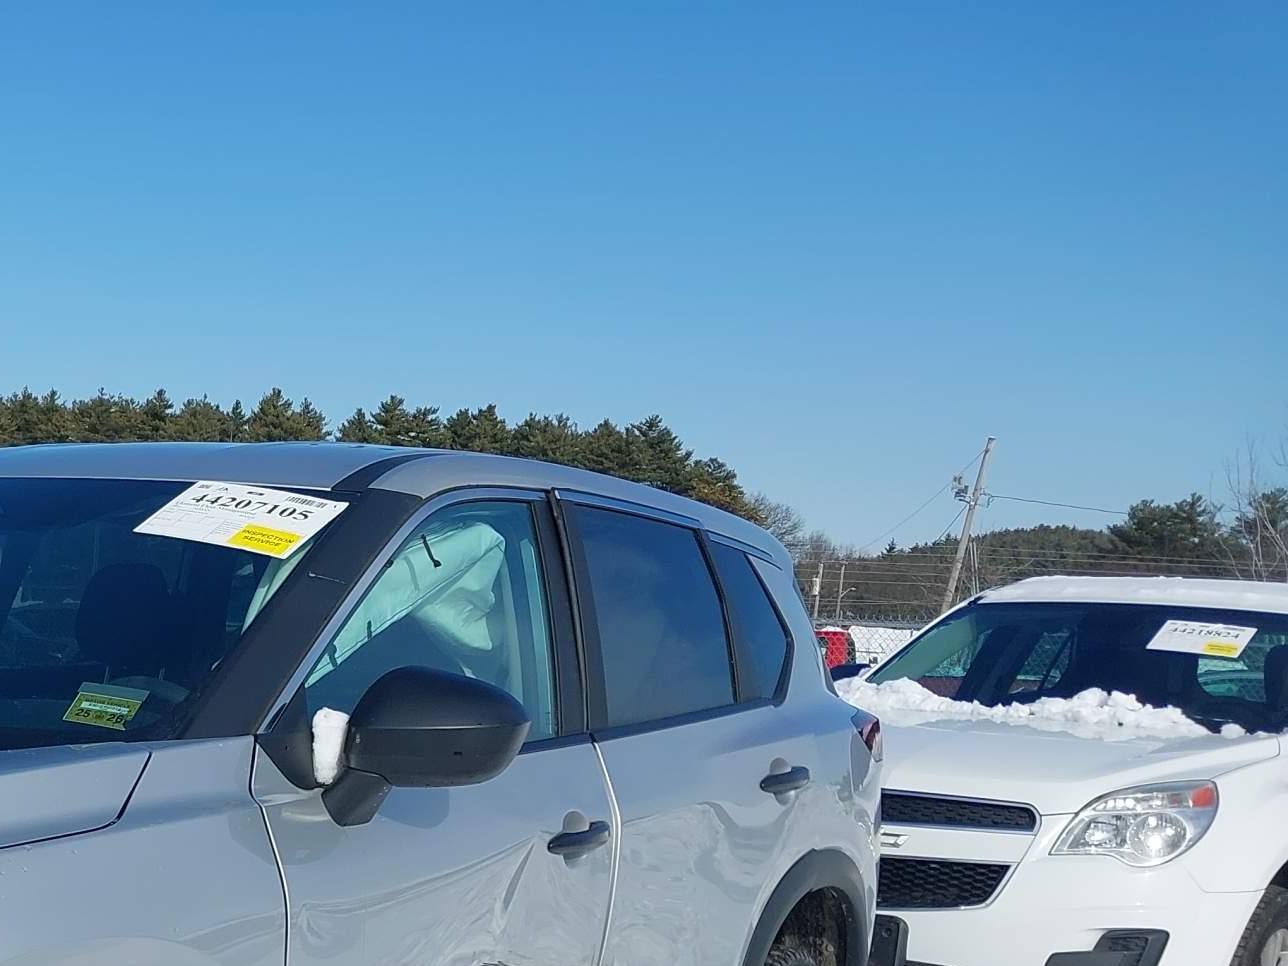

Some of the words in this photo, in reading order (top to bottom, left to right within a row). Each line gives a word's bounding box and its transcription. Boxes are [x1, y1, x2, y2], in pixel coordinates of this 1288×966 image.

[191, 493, 314, 521] 44207105
[241, 528, 295, 544] INSPECTION
[243, 535, 282, 547] SERVICE
[75, 708, 92, 718] 25
[106, 714, 124, 724] 26
